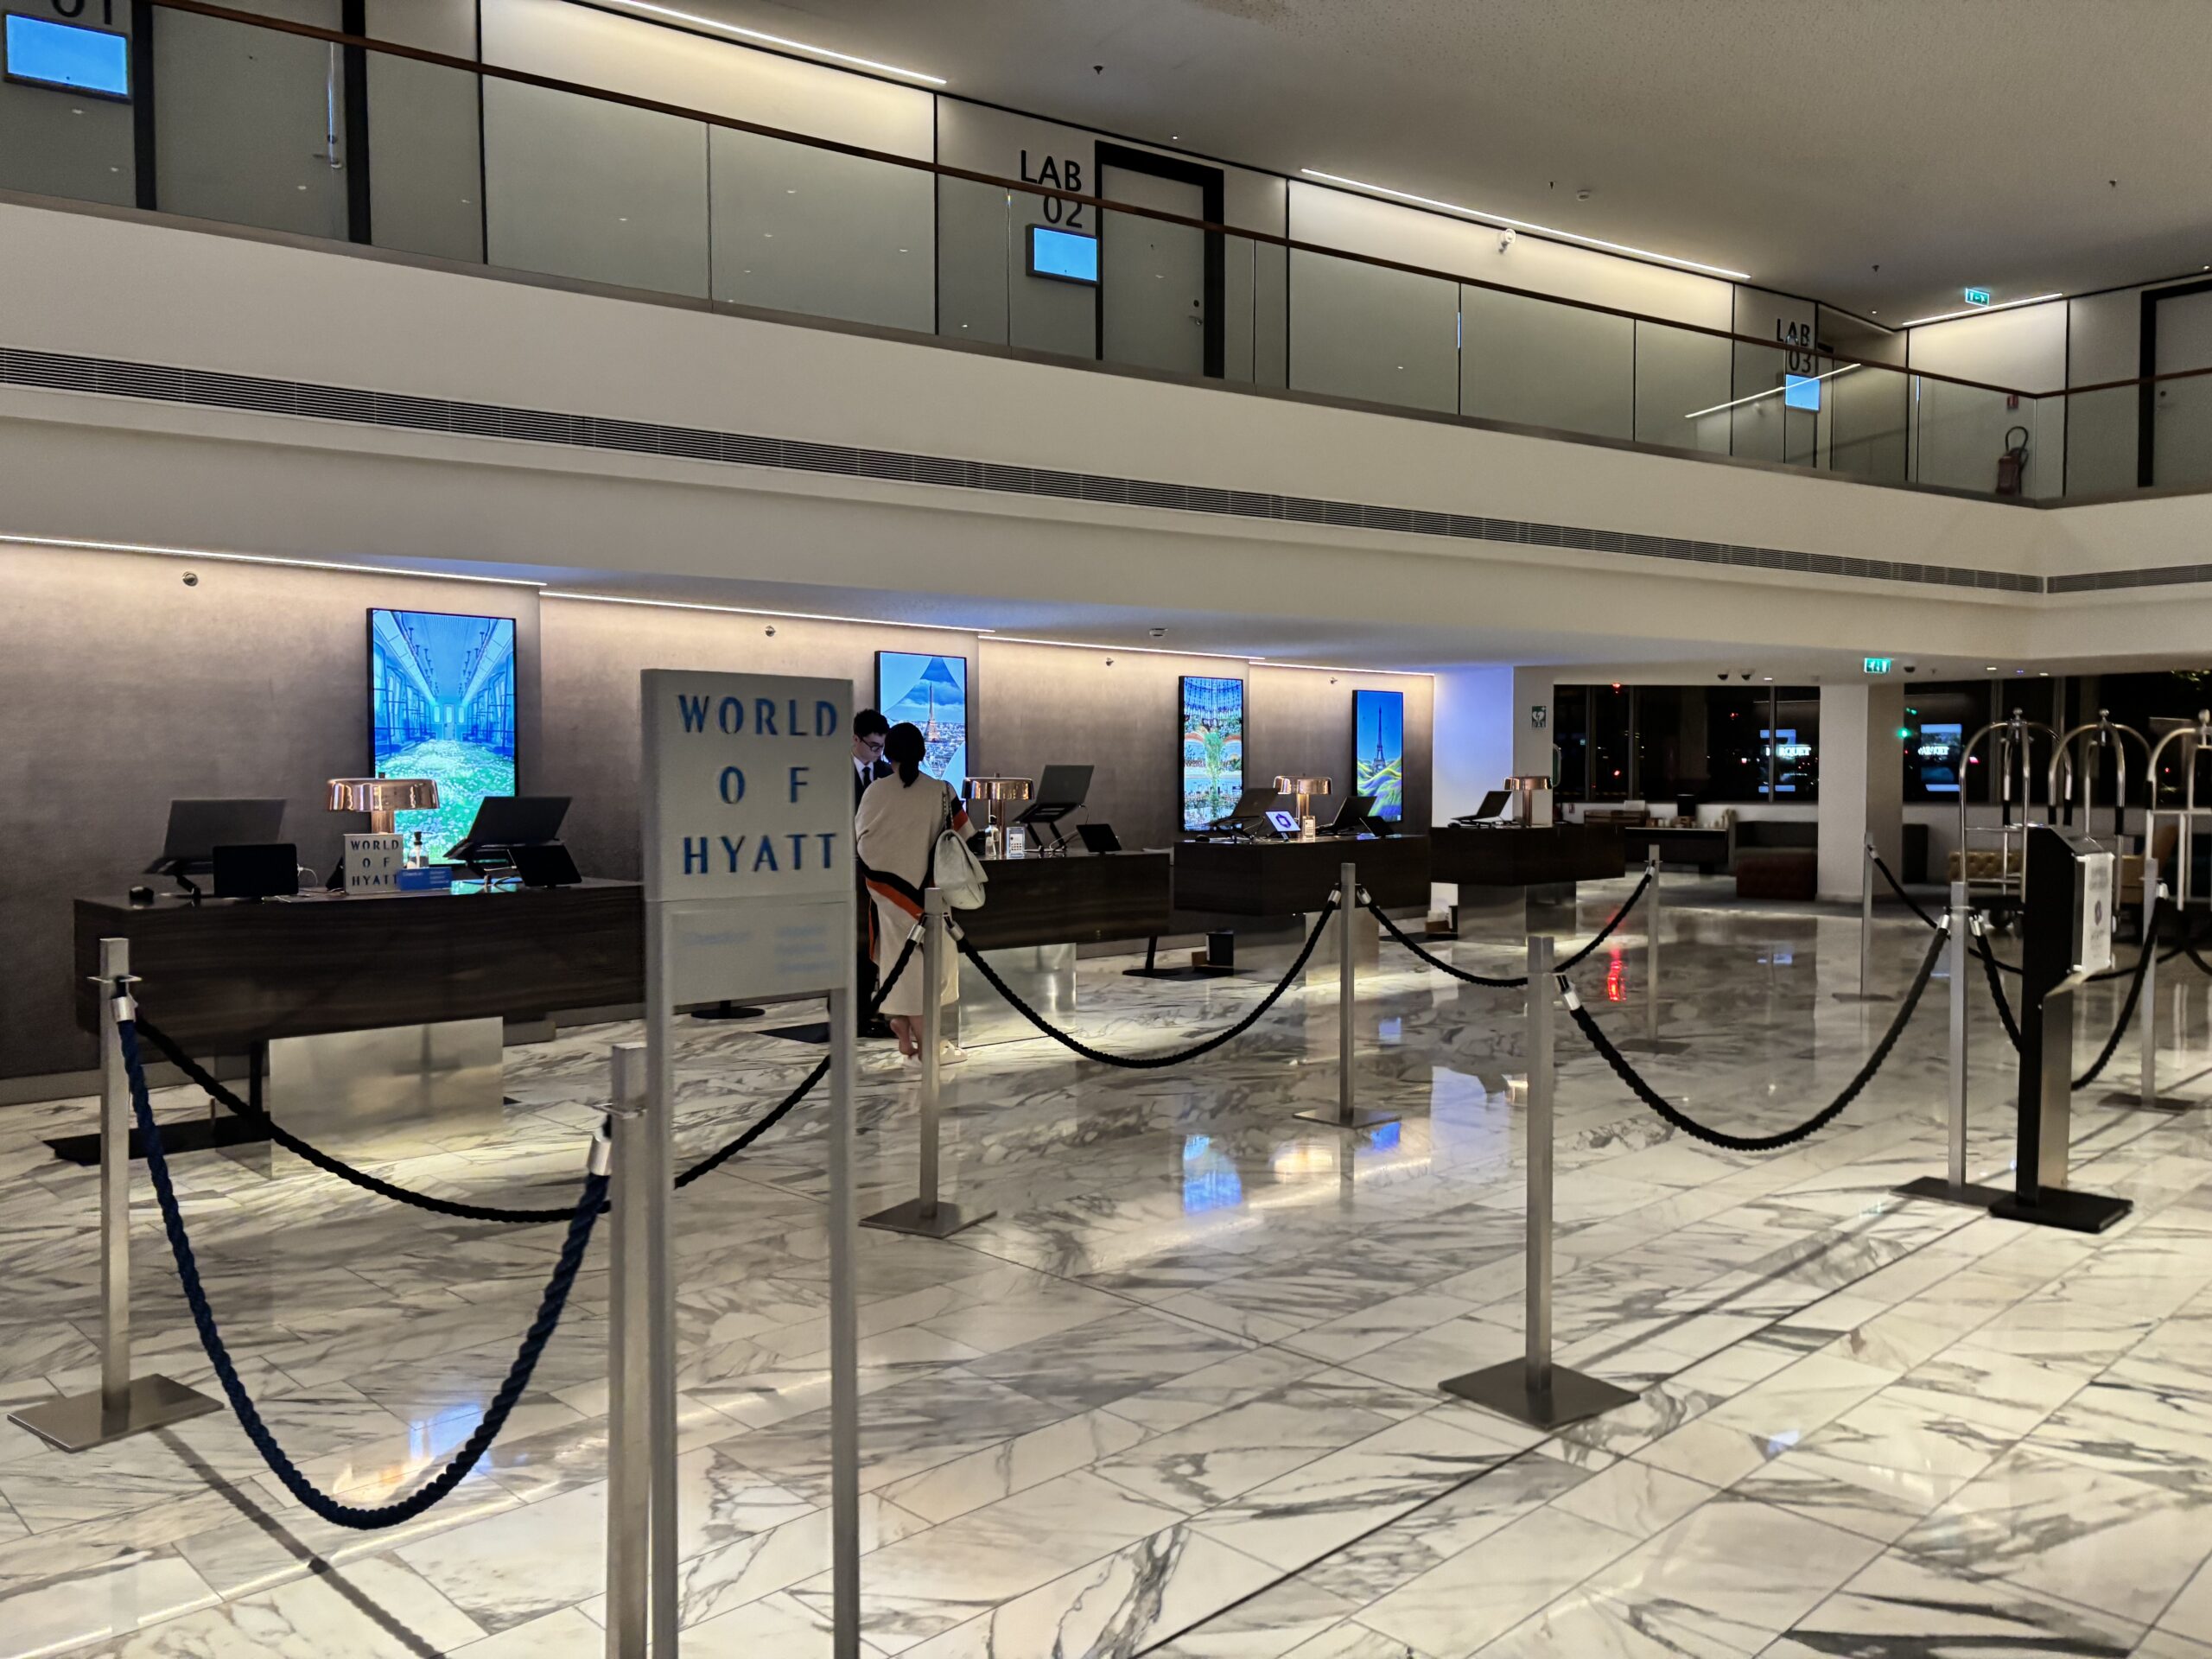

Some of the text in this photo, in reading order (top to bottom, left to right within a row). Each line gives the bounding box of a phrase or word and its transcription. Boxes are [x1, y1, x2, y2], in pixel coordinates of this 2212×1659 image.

[1020, 149, 1082, 192] LAB
[1043, 195, 1083, 228] 02
[1777, 318, 1810, 346] LAB
[1789, 350, 1812, 373] 03
[678, 695, 838, 736] WORLD
[351, 840, 399, 851] WORLD
[683, 833, 837, 874] HYATT
[352, 873, 398, 887] HYATT
